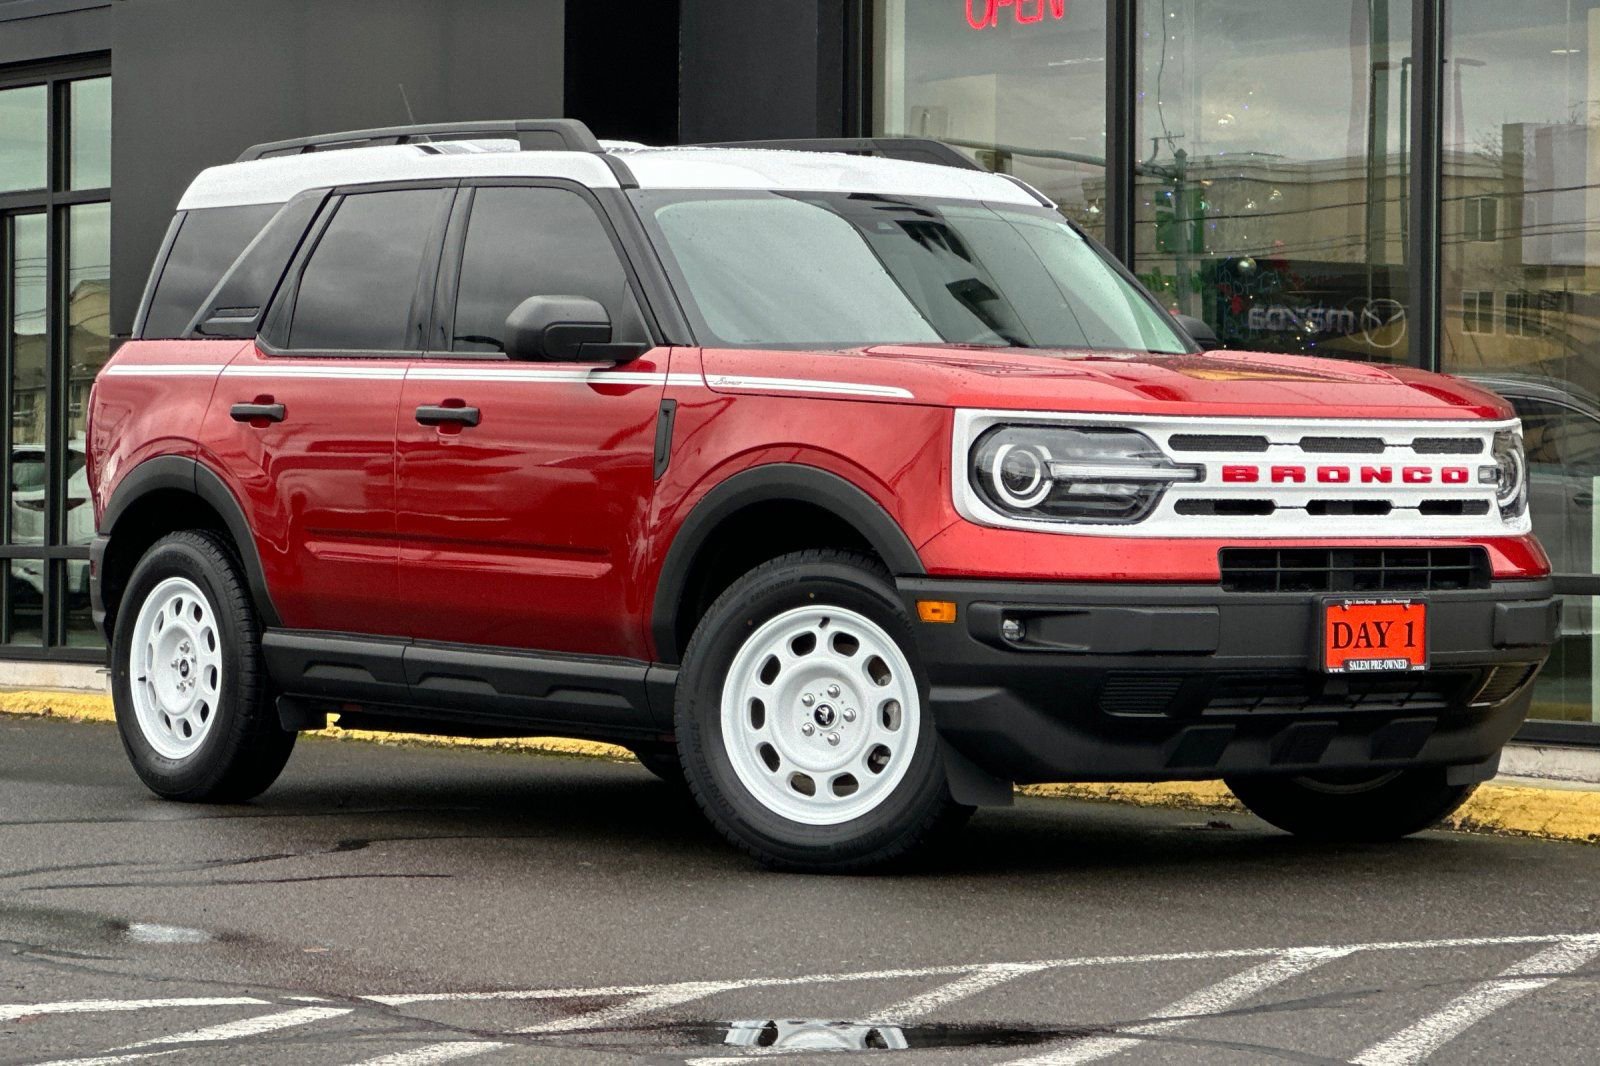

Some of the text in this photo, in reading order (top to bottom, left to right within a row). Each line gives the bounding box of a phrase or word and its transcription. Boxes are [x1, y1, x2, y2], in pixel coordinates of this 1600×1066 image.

[1222, 465, 1469, 484] BRONCO
[1331, 620, 1416, 650] DAY 1
[1349, 660, 1370, 671] SALEM
[1370, 659, 1408, 671] PRE-OWNED
